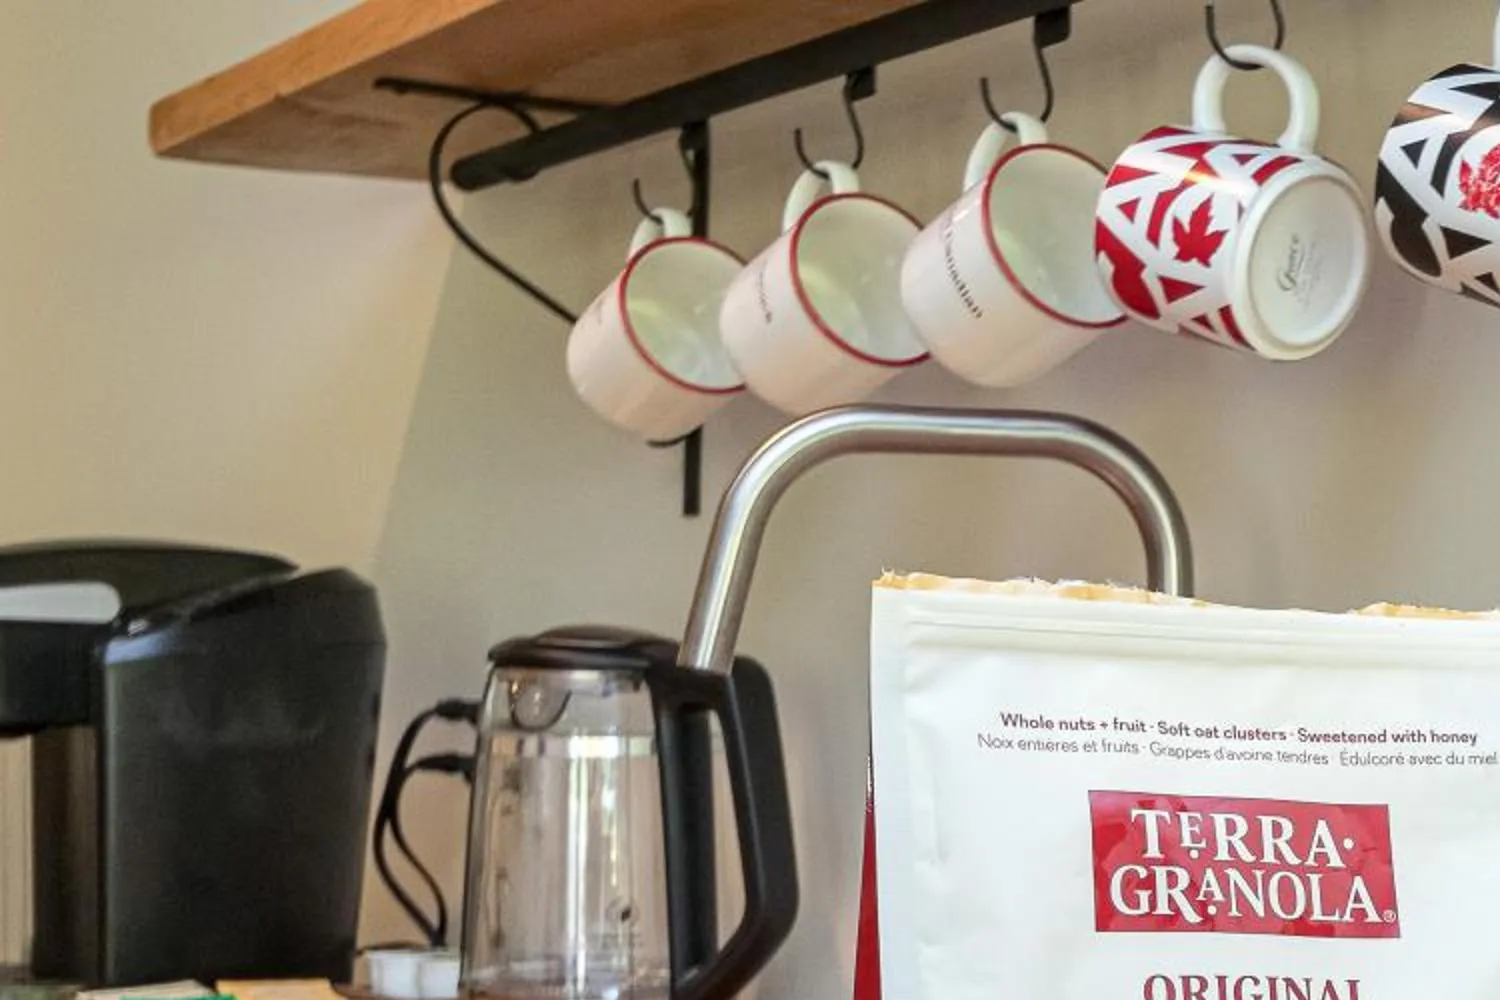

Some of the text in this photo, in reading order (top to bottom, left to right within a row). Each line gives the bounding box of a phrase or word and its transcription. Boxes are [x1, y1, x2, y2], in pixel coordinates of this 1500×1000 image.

[1000, 712, 1055, 730] Whole
[1059, 717, 1095, 731] nuts
[1113, 717, 1147, 733] fruit
[1157, 721, 1191, 737] Soft
[1194, 725, 1220, 739] oat
[1223, 725, 1287, 741] clusters
[1297, 728, 1387, 744] Sweetened
[1391, 728, 1427, 744] with
[1430, 730, 1478, 746] honey
[977, 733, 1014, 749] Noix
[1082, 739, 1098, 753] et
[1101, 739, 1140, 755] fruits
[1149, 741, 1211, 761] Grappes
[1277, 748, 1329, 765] tendres
[1340, 748, 1405, 766] Édulcoré
[1409, 752, 1442, 766] avec
[1445, 750, 1465, 766] du
[1468, 751, 1499, 765] miel
